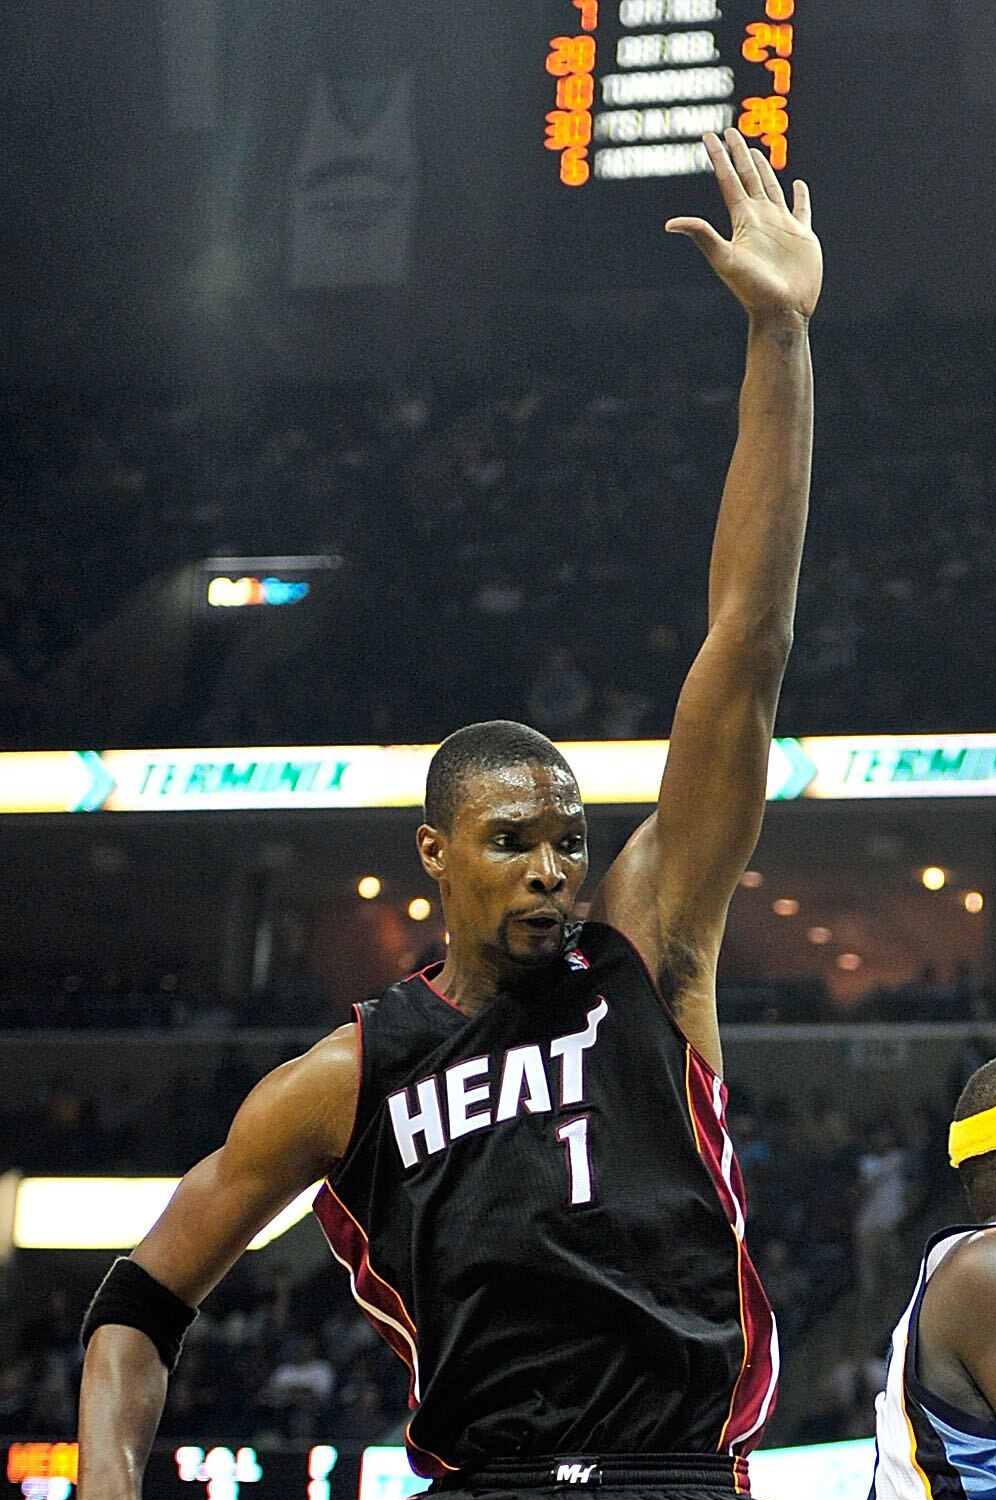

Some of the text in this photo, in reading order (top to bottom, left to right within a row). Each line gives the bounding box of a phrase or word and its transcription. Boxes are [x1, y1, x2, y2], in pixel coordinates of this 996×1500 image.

[139, 760, 352, 796] TERMINIX
[388, 994, 610, 1168] HEAT
[555, 1114, 596, 1206] 1
